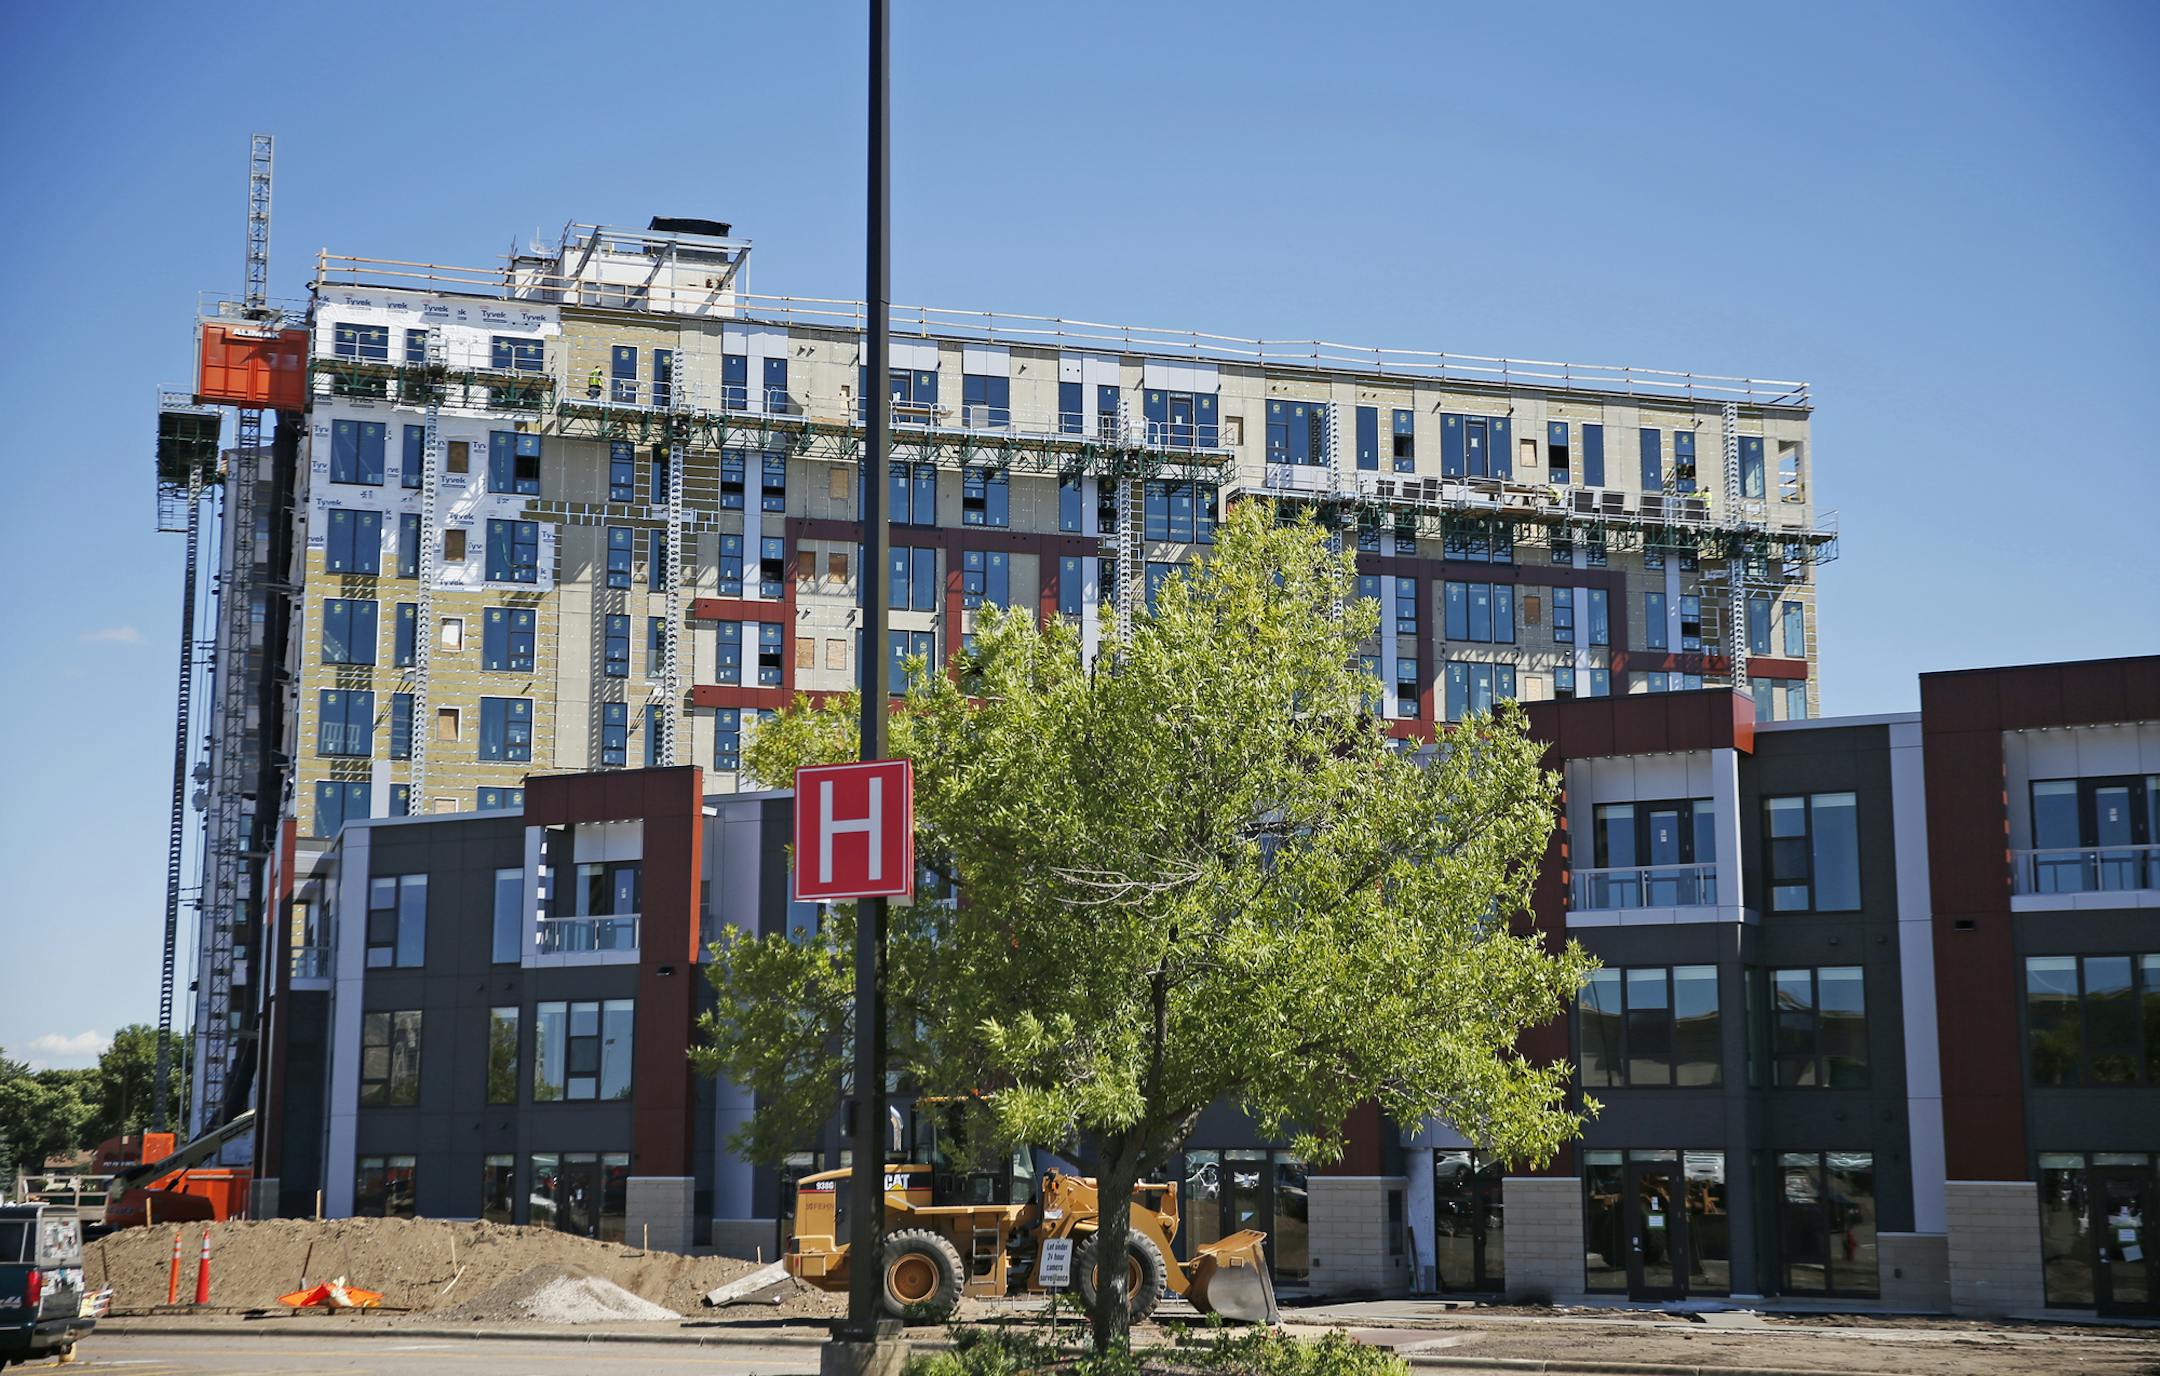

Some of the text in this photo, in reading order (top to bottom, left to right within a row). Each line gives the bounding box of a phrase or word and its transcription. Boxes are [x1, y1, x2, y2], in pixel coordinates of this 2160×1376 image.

[345, 297, 371, 307] Tyvek
[423, 303, 449, 312] Tyvek
[481, 310, 506, 319] Tyvek
[521, 313, 546, 322] Tyvek
[441, 475, 466, 484] Tyvek
[449, 512, 474, 521] Tyvek
[440, 579, 464, 587] Tyvek
[819, 777, 883, 884] H
[884, 1174, 910, 1191] CAT
